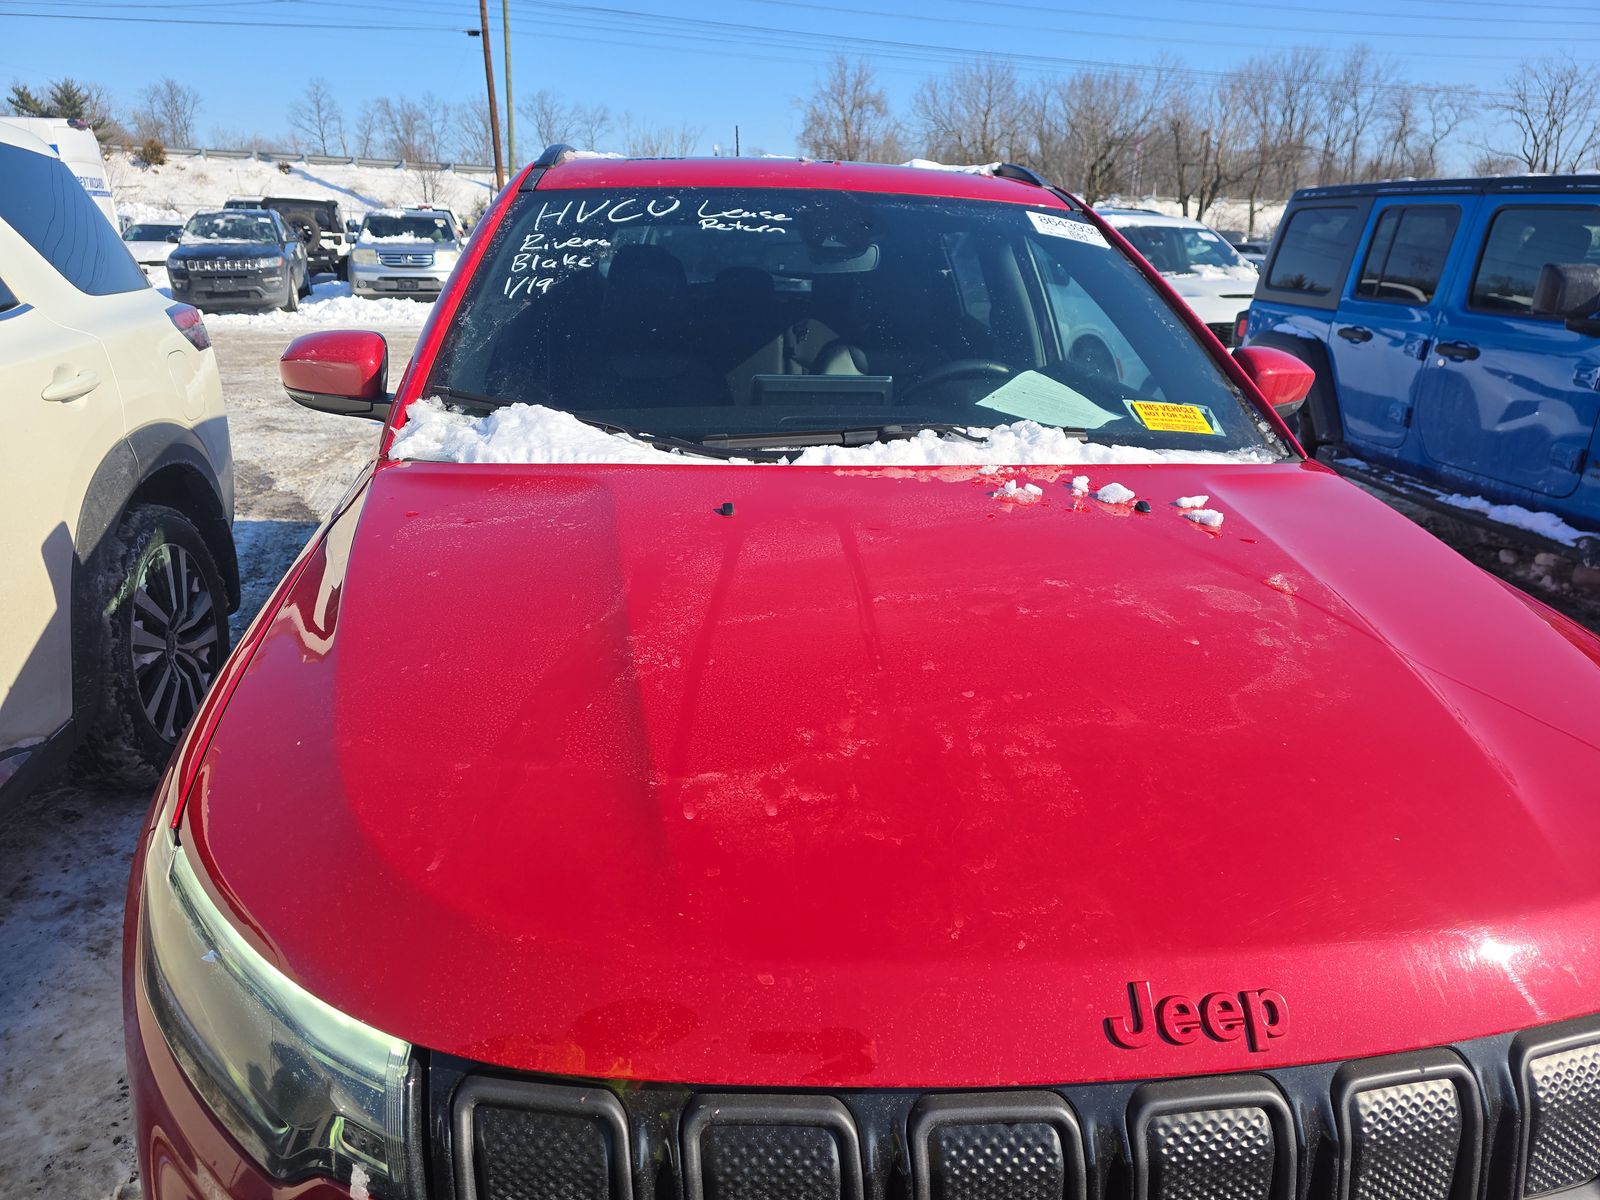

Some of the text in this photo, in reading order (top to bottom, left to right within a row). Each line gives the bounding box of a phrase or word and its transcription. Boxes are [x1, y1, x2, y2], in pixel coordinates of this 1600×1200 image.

[534, 198, 681, 231] HVCU
[697, 199, 792, 221] Lease
[698, 218, 786, 234] Return
[519, 233, 611, 252] Rivera
[511, 253, 594, 273] Blake
[503, 276, 554, 299] 1/19
[1136, 403, 1197, 414] THIS VEHICLE
[1102, 980, 1291, 1053] Jeep
